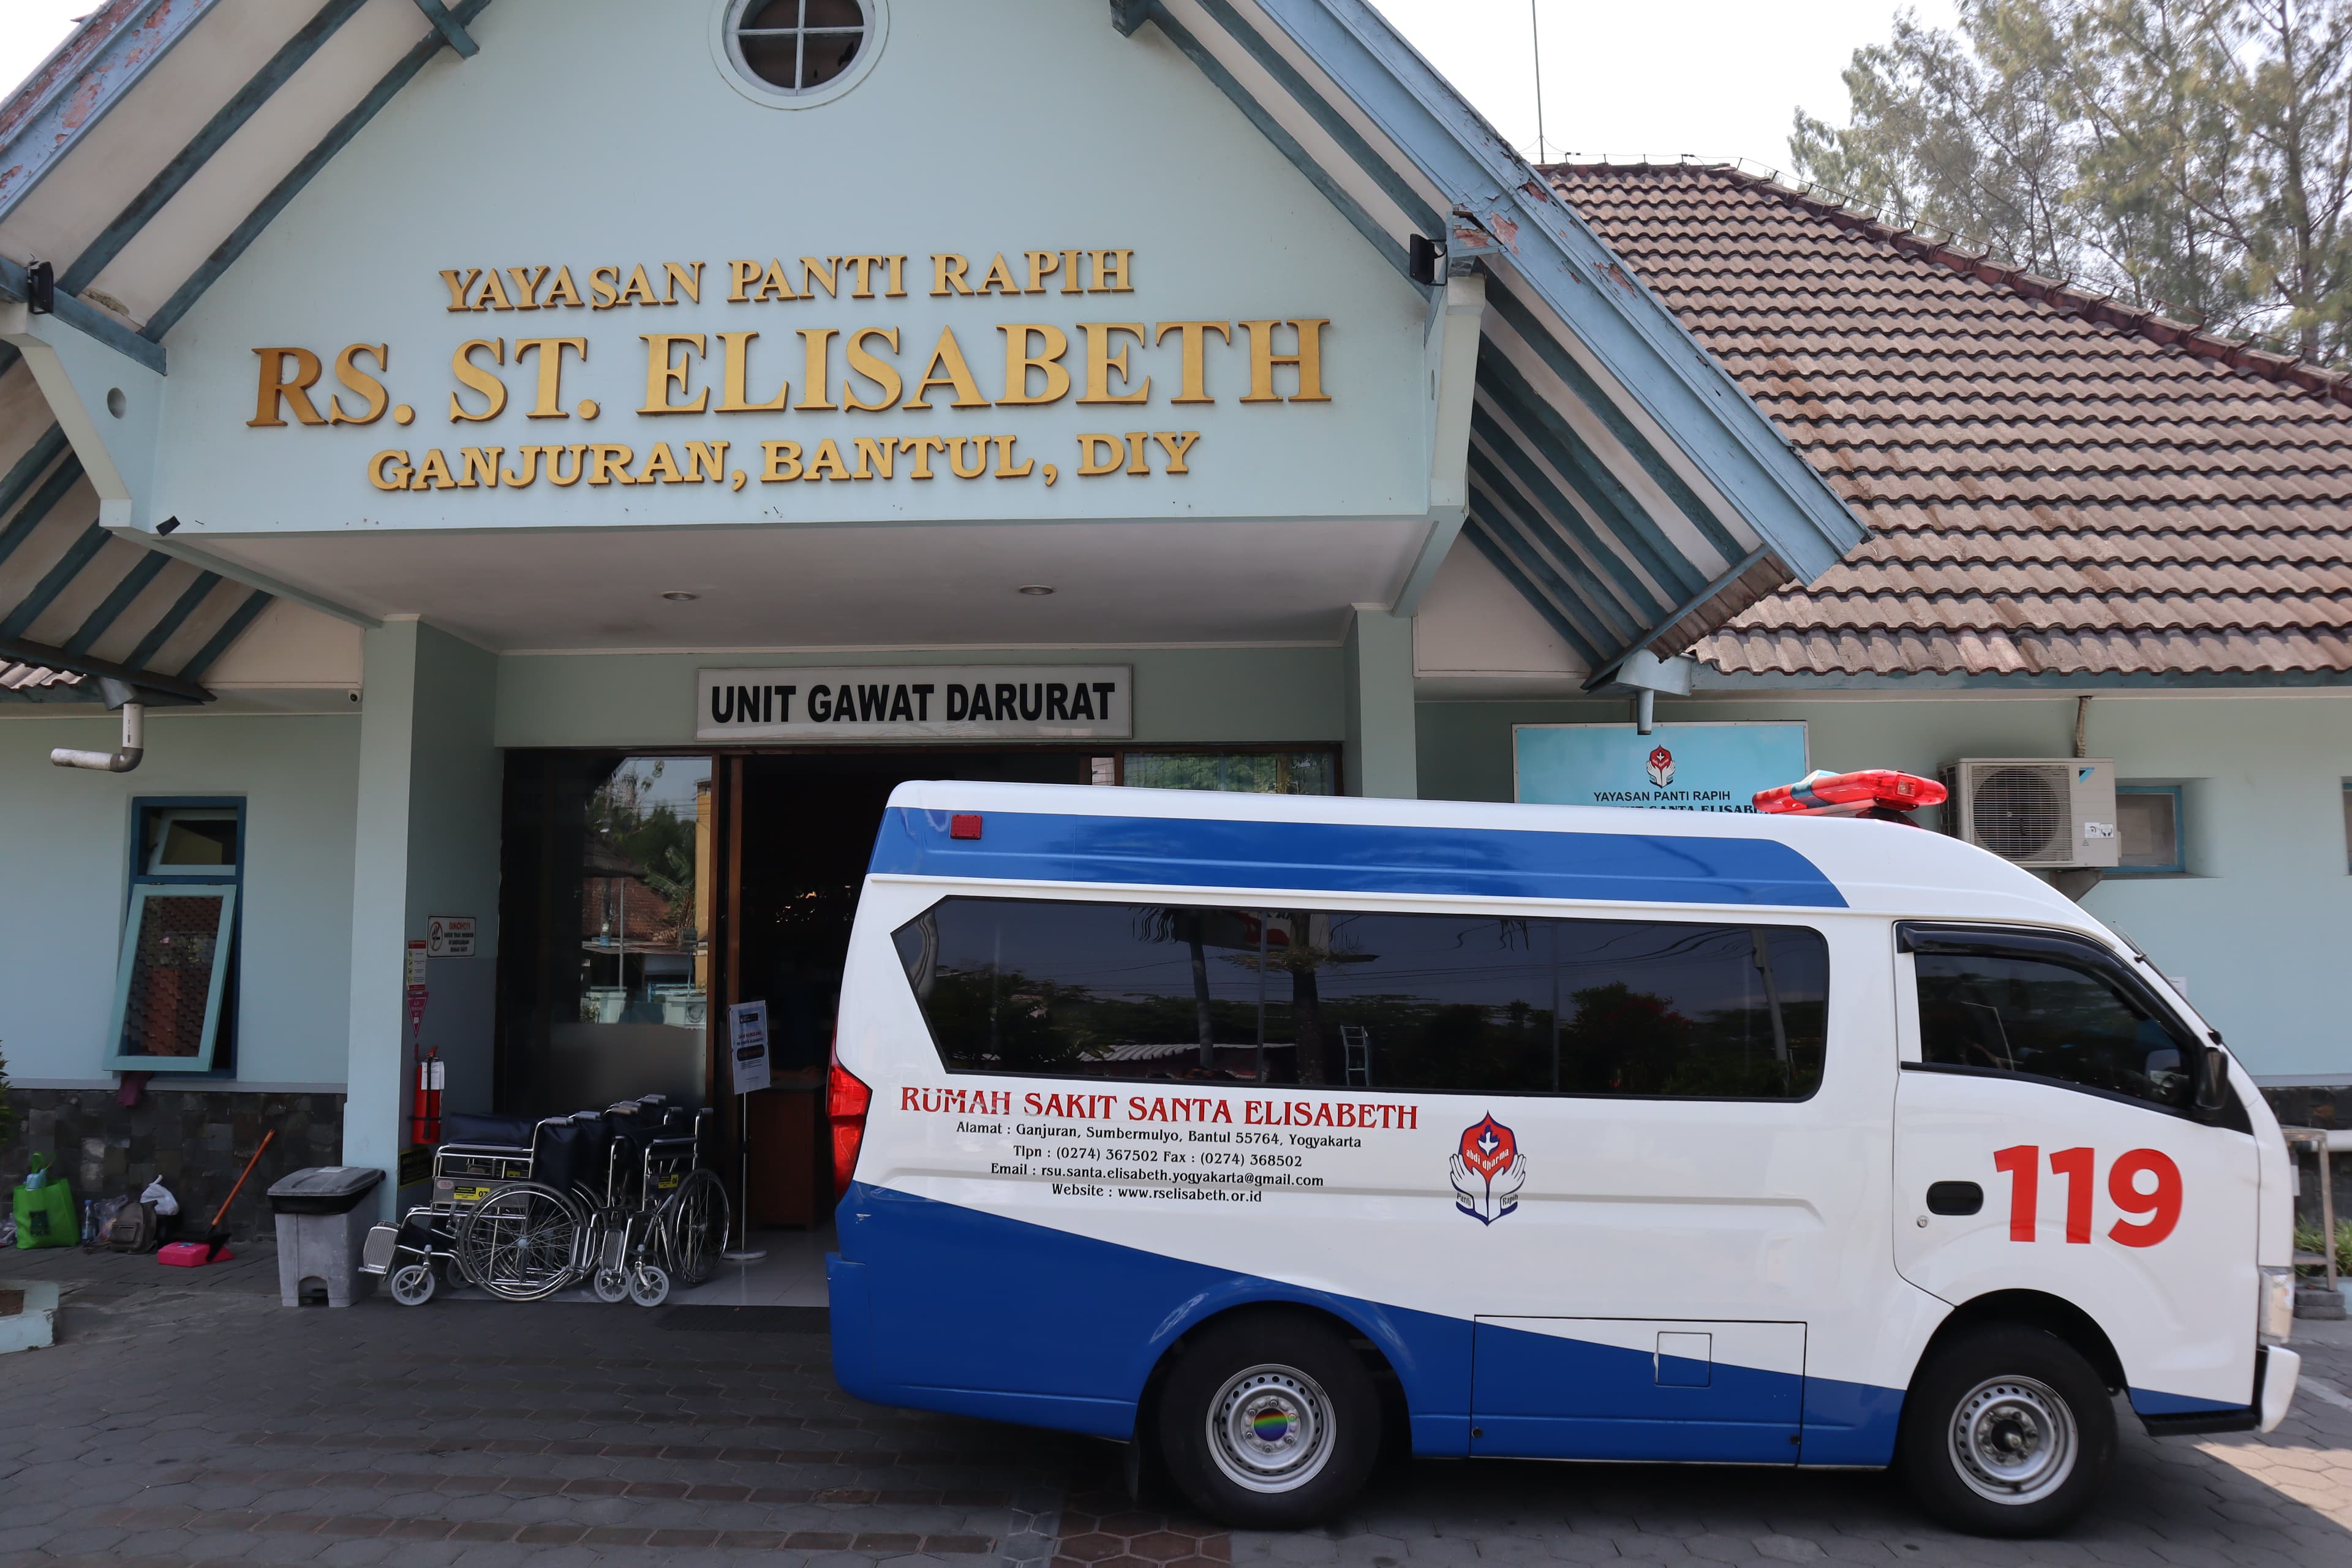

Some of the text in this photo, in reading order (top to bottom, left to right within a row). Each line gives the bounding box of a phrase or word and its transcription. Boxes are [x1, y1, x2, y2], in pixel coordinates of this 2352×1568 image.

[439, 250, 1134, 312] YAYASAN PANTI RAPIH
[246, 318, 1332, 427] RS. ST. ELISABETH
[368, 431, 1200, 492] GANJURAN, BANTUL, DIY
[711, 682, 1115, 723] UNIT GAWAT DARURAT
[1594, 791, 1730, 802] YAYASAN PANTI RAPIH
[900, 1087, 1418, 1129] RUMAH SAKIT SANTA ELISABETH
[956, 1121, 1002, 1134] Alamat
[1016, 1124, 1081, 1139] Ganjuran,
[1086, 1126, 1183, 1143] Sumbermulyo,
[1188, 1131, 1231, 1143] Bantul
[1235, 1132, 1283, 1145] 55764,
[1289, 1134, 1362, 1148] Yogyakarta
[1013, 1145, 1042, 1159] Tlpn
[1057, 1147, 1101, 1161] (0274)
[1106, 1148, 1158, 1162] 367502
[1163, 1152, 1186, 1163] Fax
[1200, 1152, 1245, 1166] (0274)
[1250, 1154, 1302, 1167] 368502
[1466, 1148, 1509, 1171] abdi dharma
[991, 1163, 1027, 1175] Email
[1041, 1166, 1324, 1187] rsu.santa.elisabeth.yogyakarta@gmail.com
[1052, 1184, 1104, 1197] Website
[1118, 1187, 1262, 1203] www.rselisabeth.or.id
[1457, 1193, 1471, 1206] Panti
[1502, 1194, 1518, 1206] Rapih
[1994, 1145, 2183, 1248] 119
